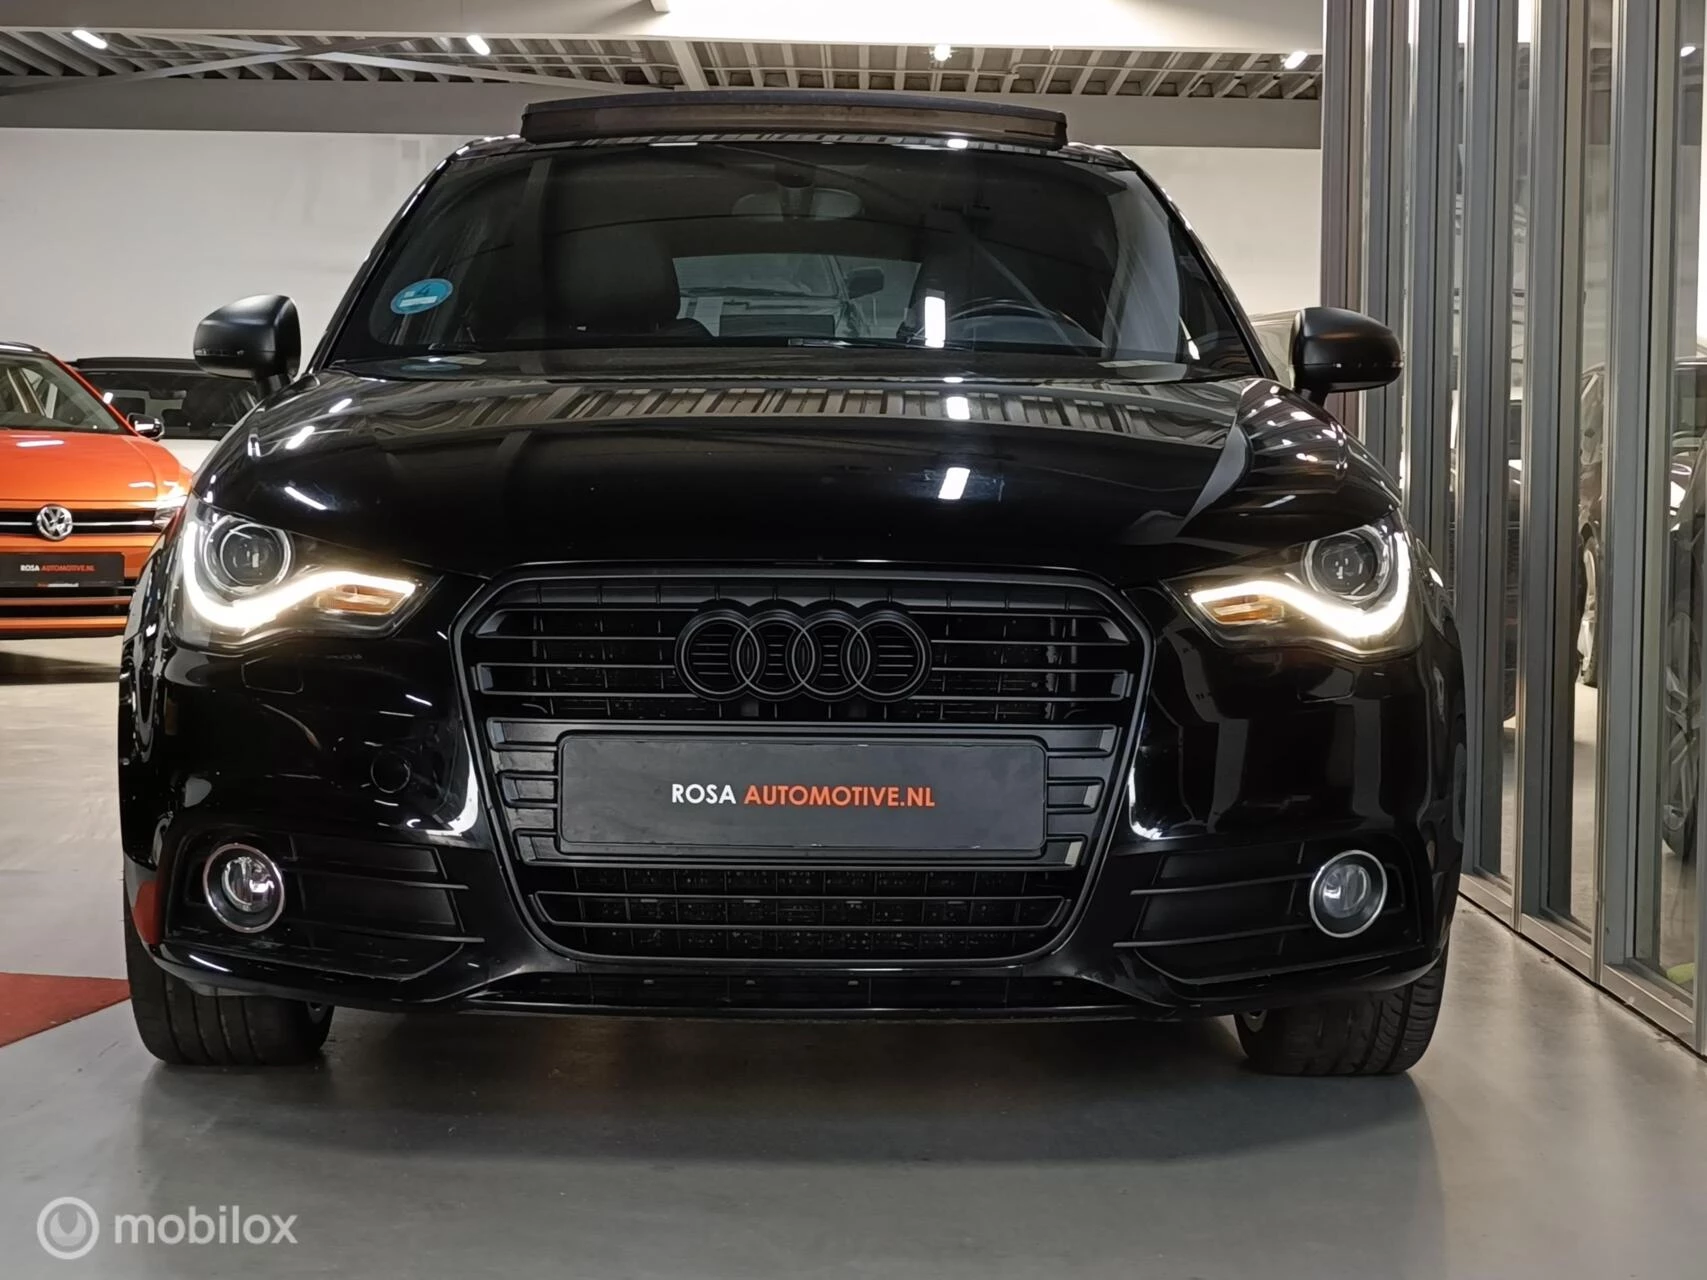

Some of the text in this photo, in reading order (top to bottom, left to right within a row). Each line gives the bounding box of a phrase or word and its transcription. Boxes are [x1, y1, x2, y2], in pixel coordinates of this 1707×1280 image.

[20, 564, 40, 572] ROSA
[671, 783, 935, 807] ROSA AUTOMOTIVE.NL
